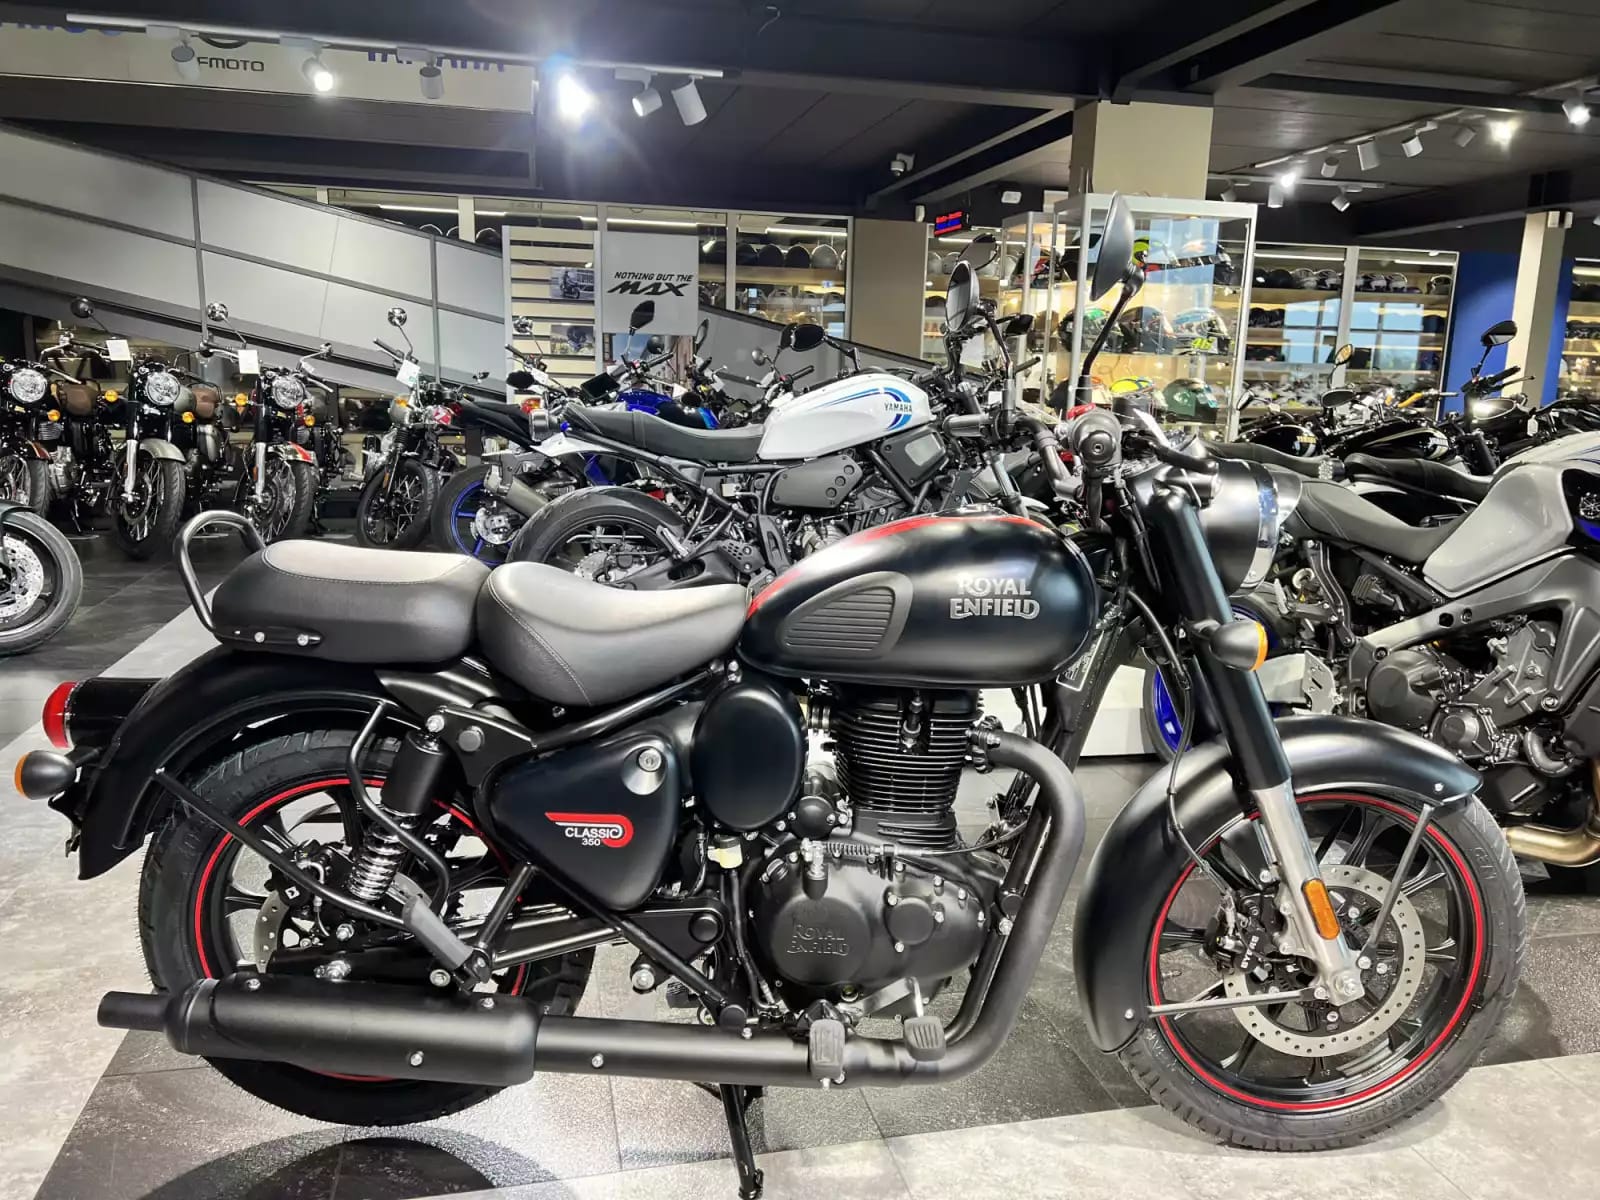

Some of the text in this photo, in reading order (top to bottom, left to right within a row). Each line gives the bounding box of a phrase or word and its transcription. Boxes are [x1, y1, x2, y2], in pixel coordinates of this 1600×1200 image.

[197, 57, 264, 72] FMOTO
[615, 272, 654, 280] NOTHING
[607, 281, 689, 296] MAX
[884, 402, 912, 412] YAMAHA
[958, 578, 1032, 597] ROYAL
[950, 598, 1040, 619] ENFIELD
[565, 827, 623, 839] CLASSIC
[581, 838, 601, 846] 350
